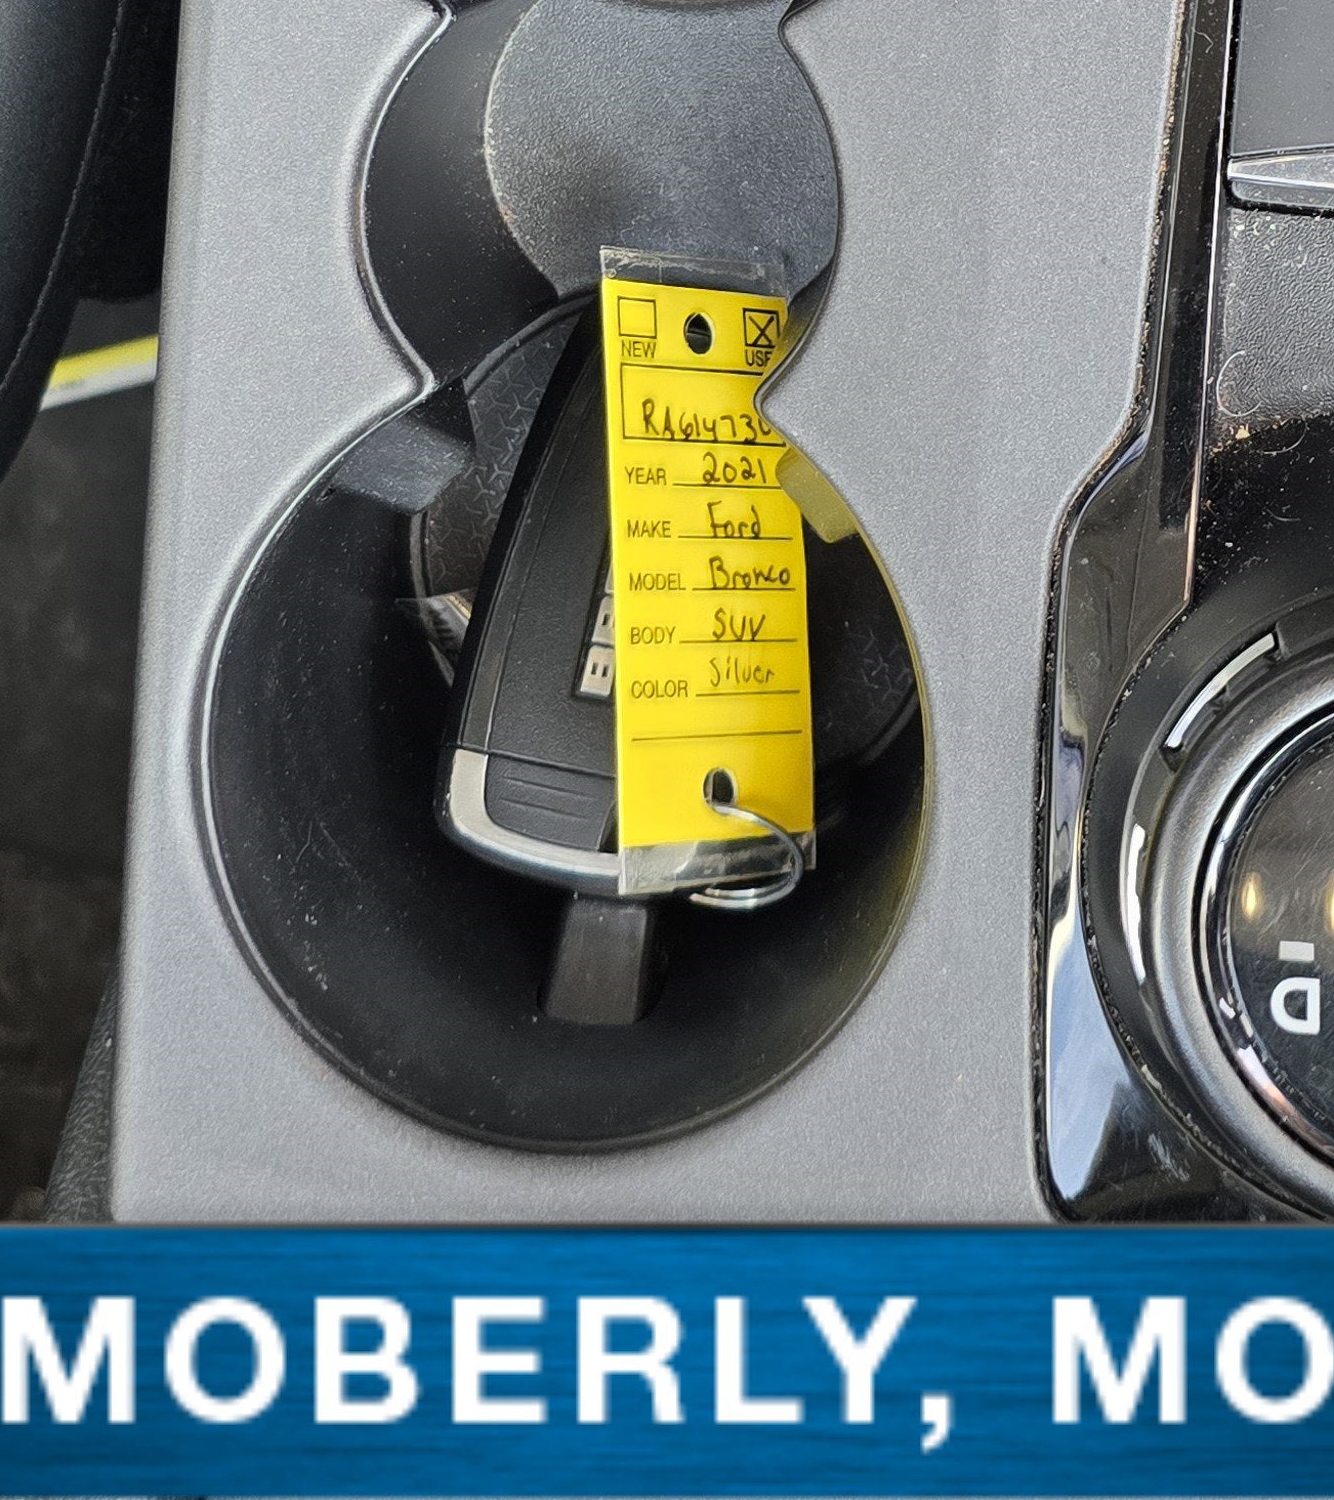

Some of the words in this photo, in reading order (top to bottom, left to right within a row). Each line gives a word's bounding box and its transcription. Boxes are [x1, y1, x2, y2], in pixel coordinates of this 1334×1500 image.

[621, 340, 656, 359] NEW
[624, 466, 667, 486] YEAR
[702, 451, 767, 485] 2021
[626, 519, 672, 538] MAKE
[706, 500, 761, 539] Ford
[628, 572, 686, 591] MODEL
[708, 555, 791, 590] Bronco
[630, 626, 676, 645] BODY
[712, 607, 766, 642] SUV
[631, 679, 689, 699] COLOR
[709, 655, 775, 687] Silver
[1269, 976, 1322, 1036] D
